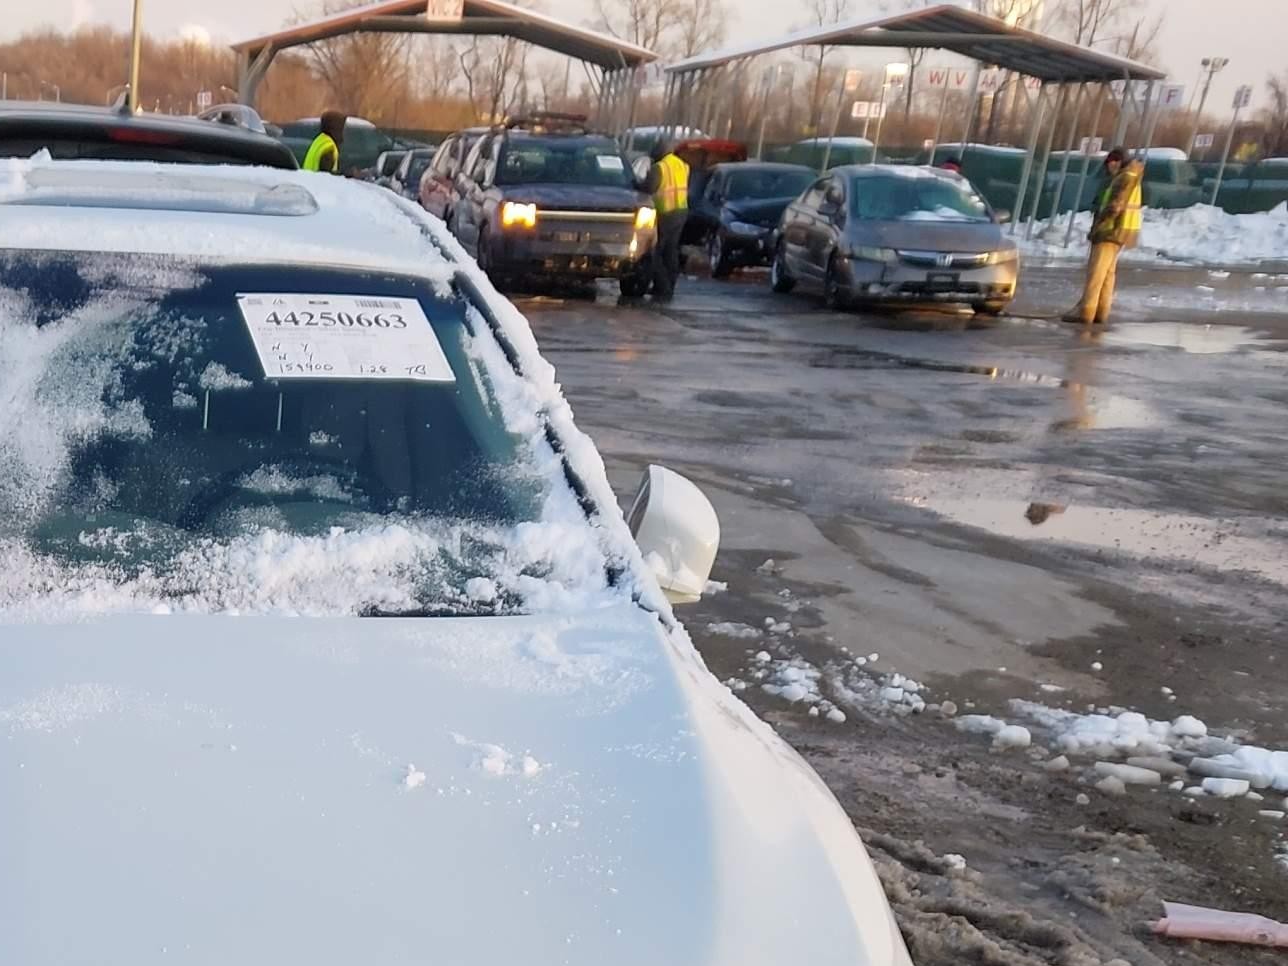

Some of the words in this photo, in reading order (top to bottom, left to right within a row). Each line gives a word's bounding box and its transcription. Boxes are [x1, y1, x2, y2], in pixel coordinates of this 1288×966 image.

[929, 71, 943, 85] W
[956, 71, 967, 85] V
[1166, 89, 1179, 104] F
[265, 311, 408, 329] 44250663
